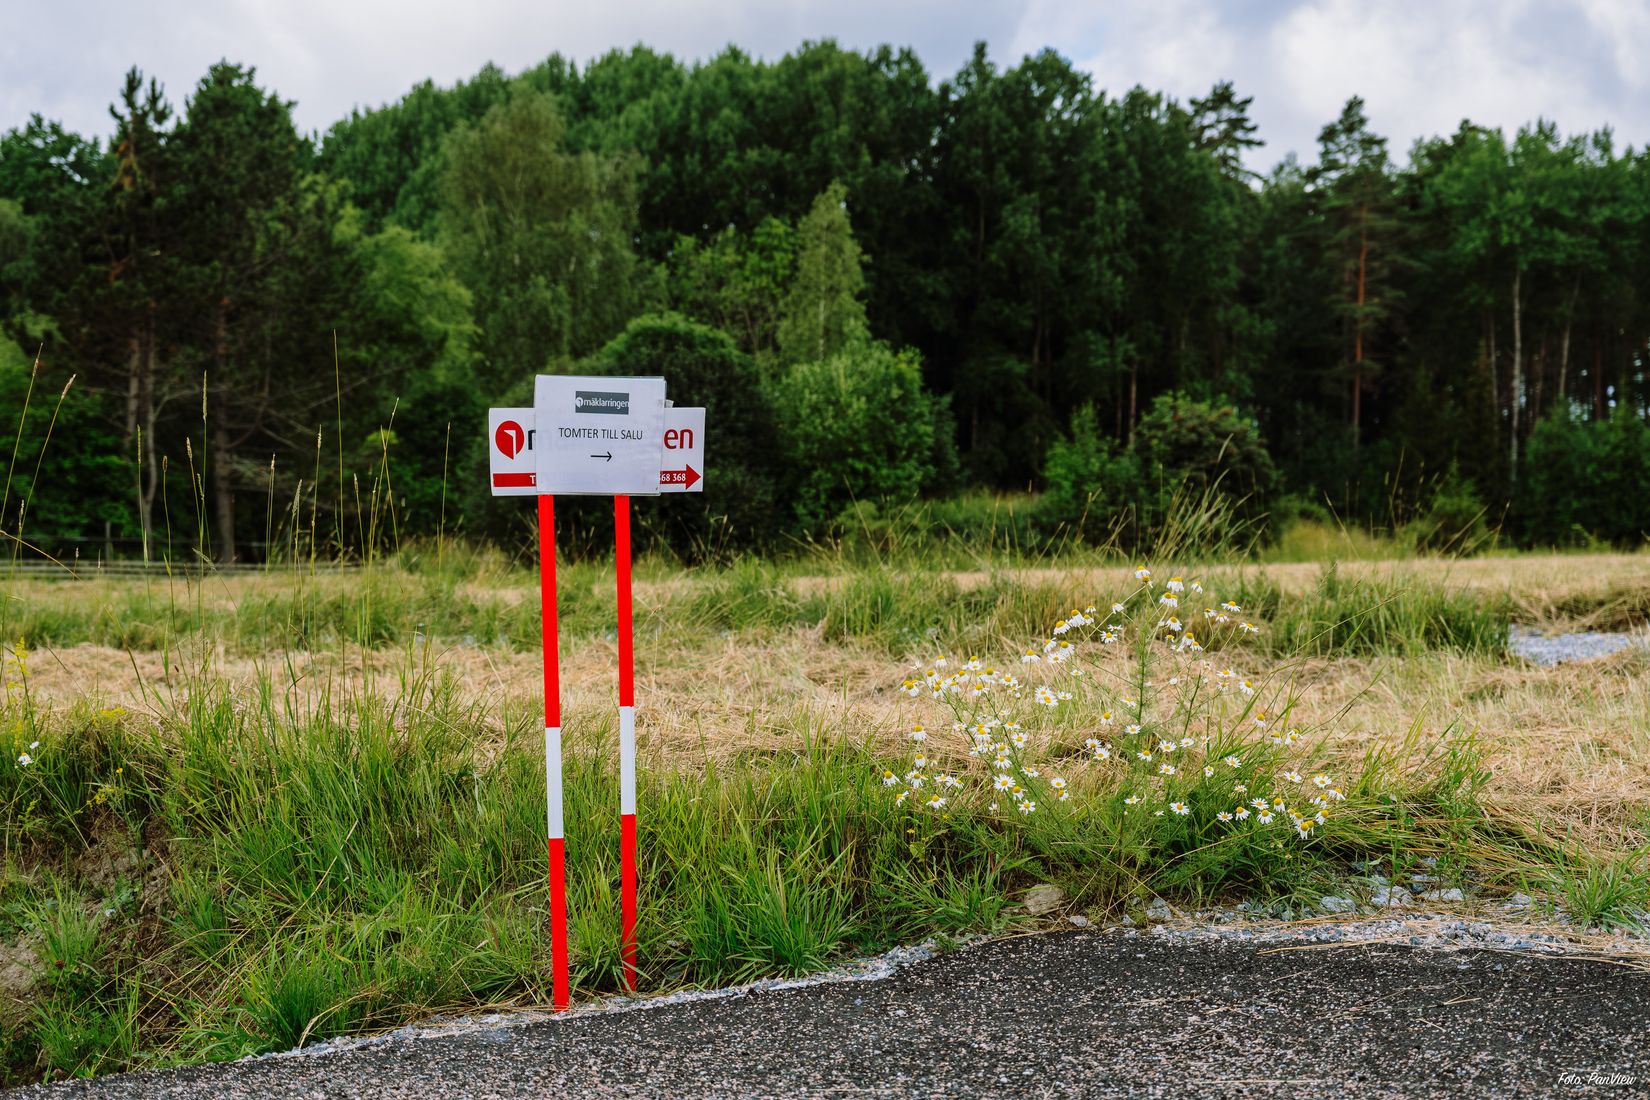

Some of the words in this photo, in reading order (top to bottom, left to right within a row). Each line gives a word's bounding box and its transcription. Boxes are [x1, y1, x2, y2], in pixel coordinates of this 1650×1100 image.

[584, 397, 629, 410] mäklarringen
[558, 427, 599, 439] TOMTER
[601, 429, 618, 440] TILL
[620, 429, 643, 441] SALU
[672, 473, 687, 482] 368
